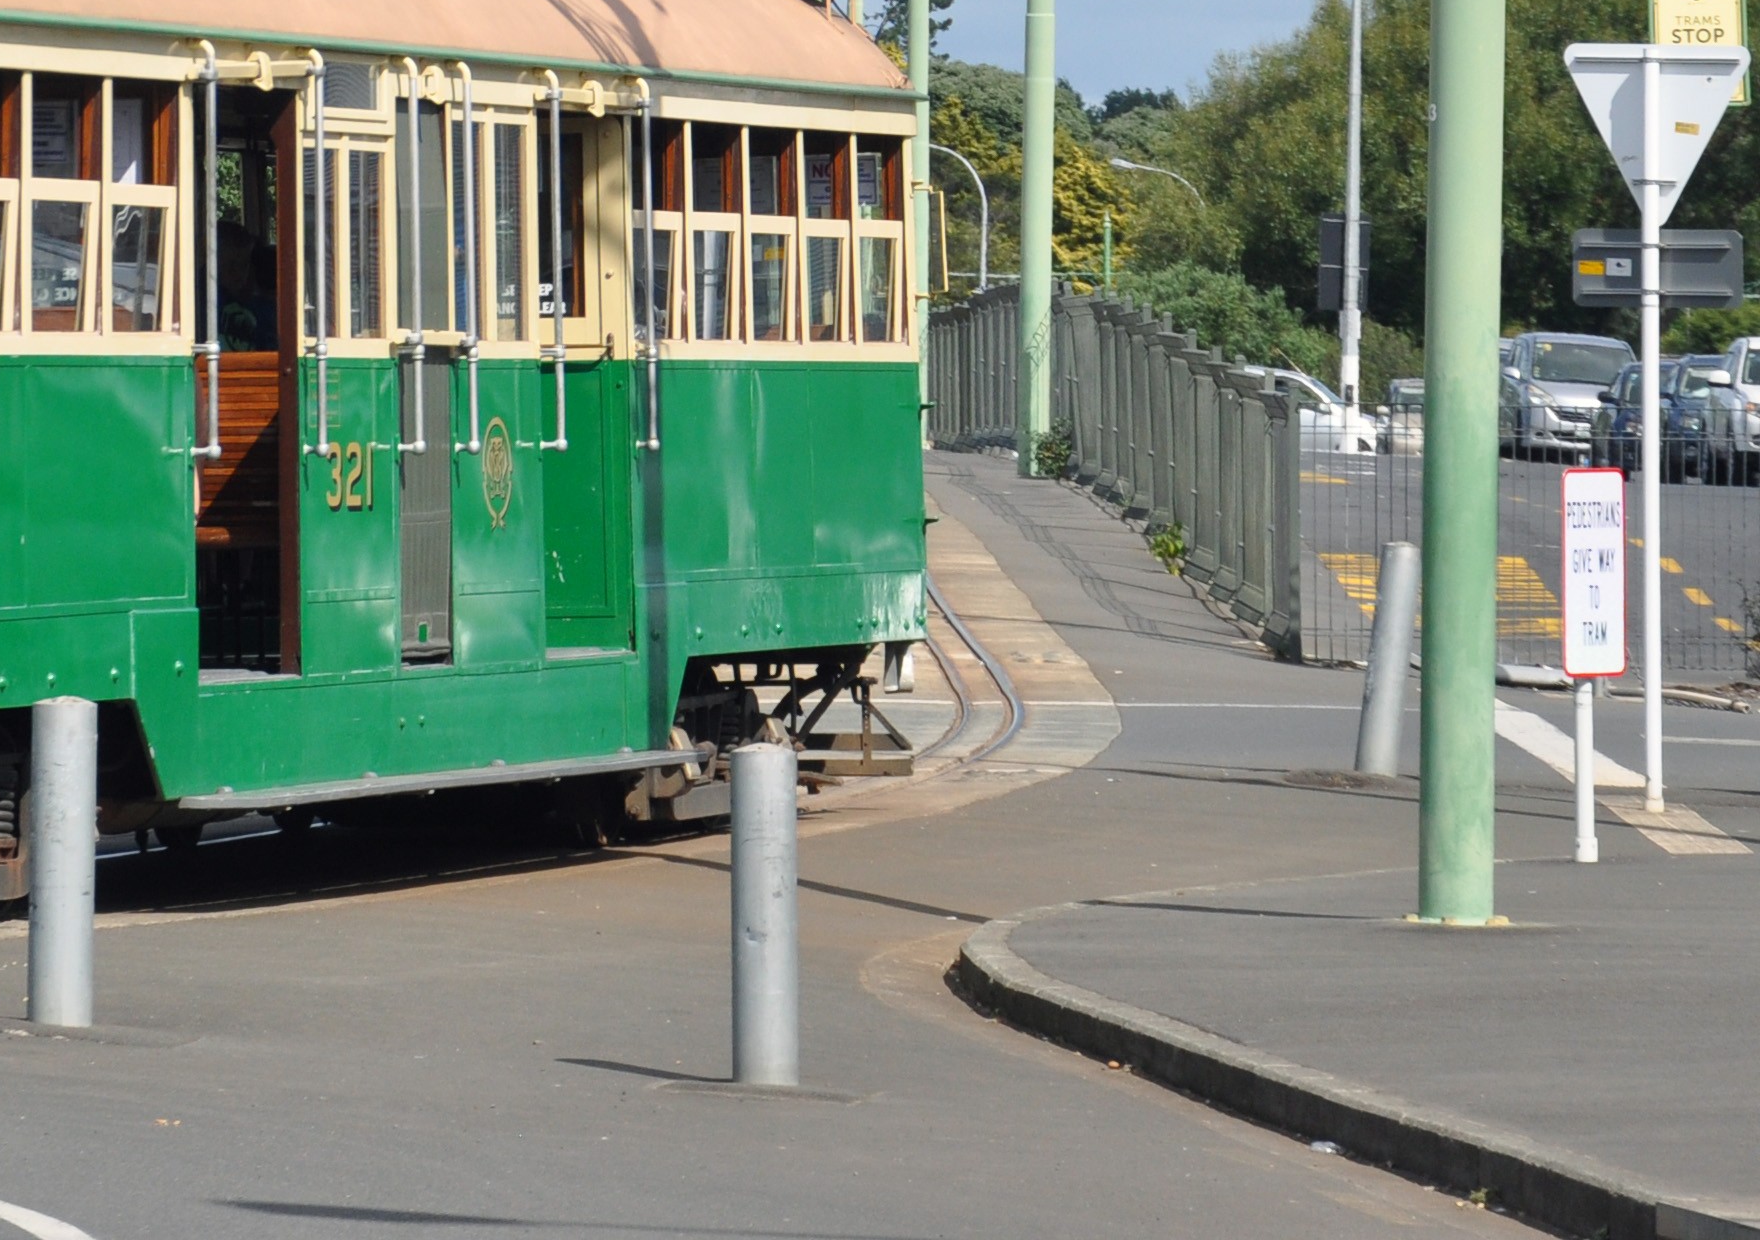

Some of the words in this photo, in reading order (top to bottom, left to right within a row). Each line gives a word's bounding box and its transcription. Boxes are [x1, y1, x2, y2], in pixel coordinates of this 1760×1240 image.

[1674, 15, 1721, 26] TRAMS
[1671, 27, 1725, 44] STOP
[326, 442, 373, 511] 321
[1566, 501, 1621, 528] PEDESTRIANS
[1572, 548, 1593, 573] GIVE
[1598, 548, 1616, 573] WAY
[1588, 584, 1601, 609] TO
[1582, 621, 1608, 646] TRAM
